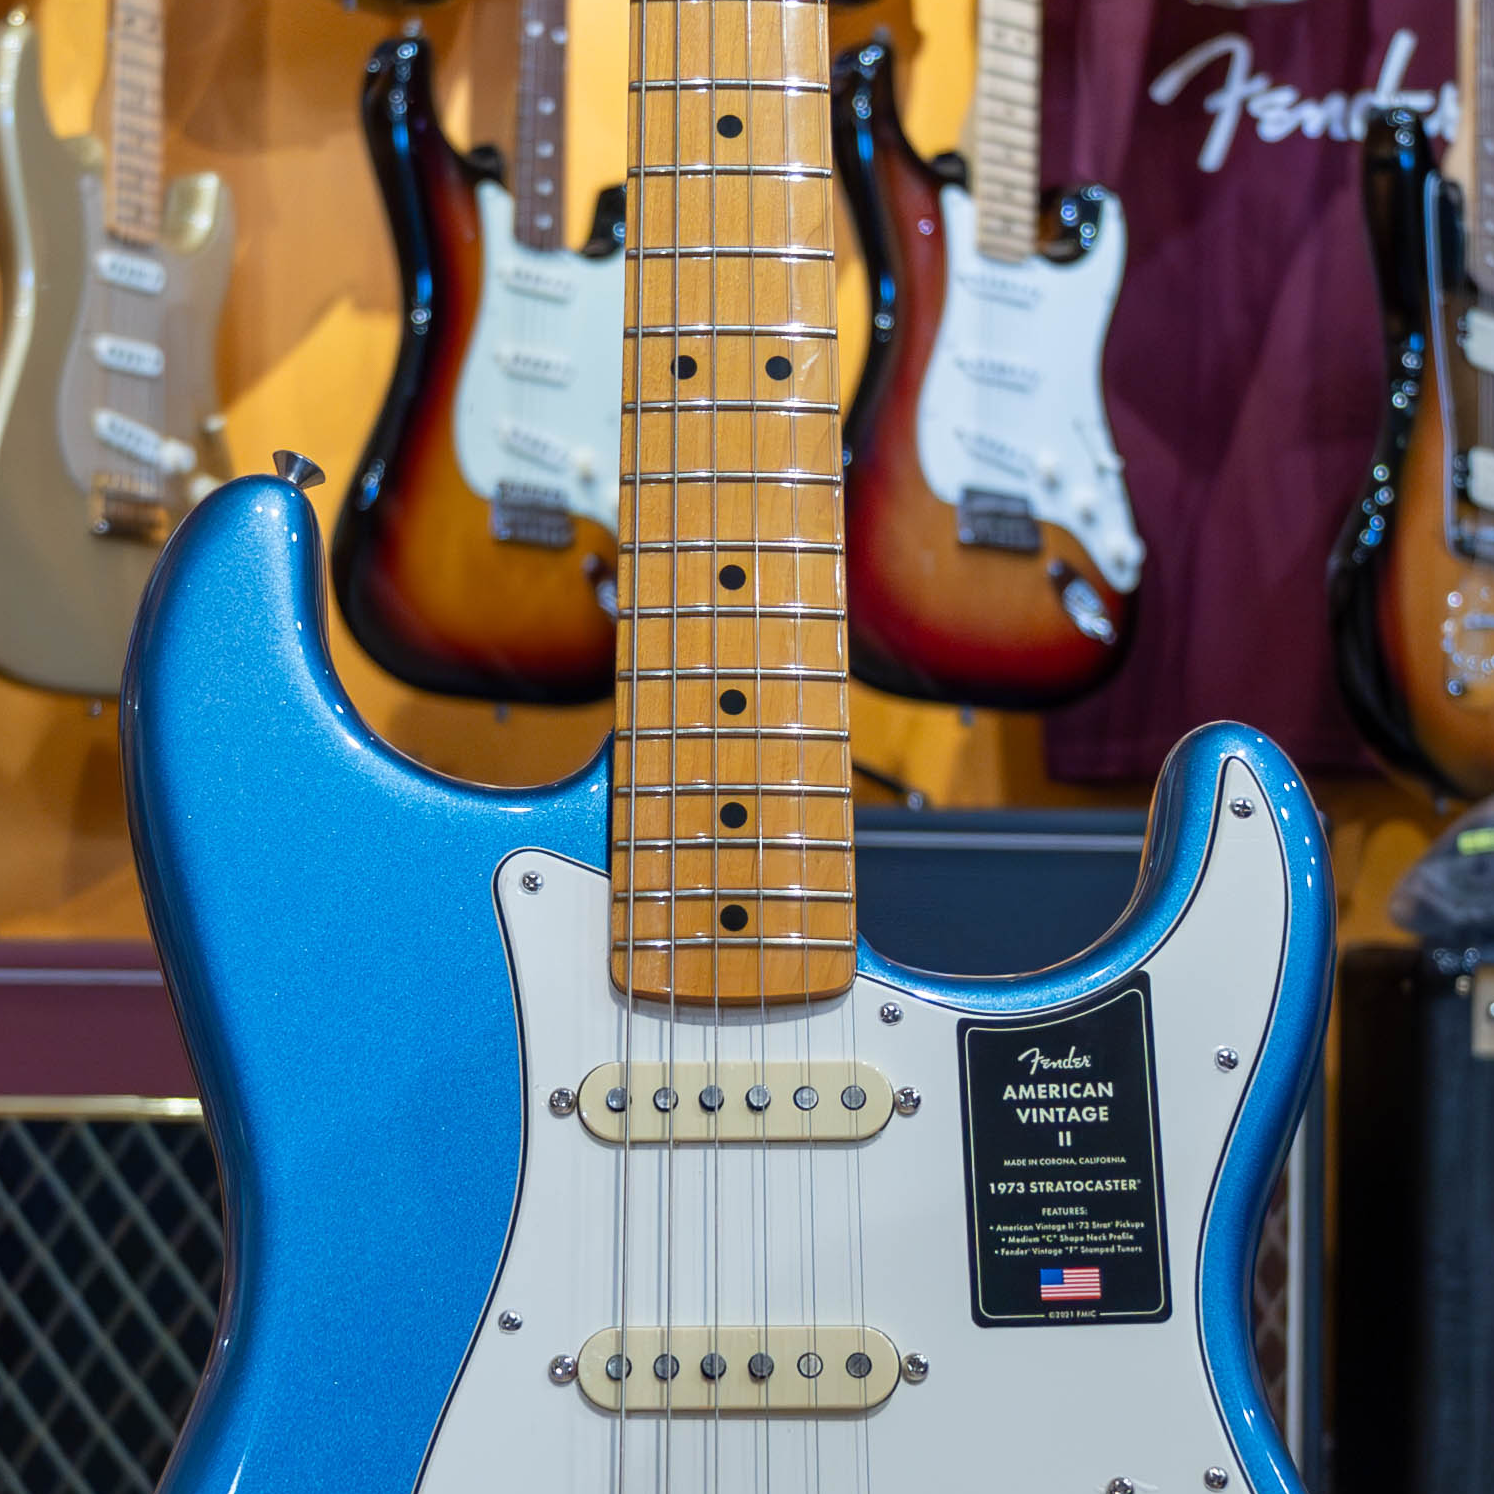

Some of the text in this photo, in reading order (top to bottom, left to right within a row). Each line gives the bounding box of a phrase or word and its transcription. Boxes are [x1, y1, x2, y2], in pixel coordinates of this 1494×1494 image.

[1018, 1046, 1091, 1075] Fender
[1003, 1082, 1113, 1100] AMERICAN
[1016, 1106, 1109, 1123] VINTAGE
[1058, 1131, 1072, 1146] II
[989, 1182, 1025, 1195] 1973
[1042, 1207, 1088, 1216] FEATURES:
[1035, 1223, 1066, 1232] Vintage
[1115, 1221, 1144, 1229] Pickups
[1008, 1236, 1039, 1244] Medium
[1060, 1235, 1084, 1243] Shape
[1032, 1247, 1063, 1256] Vintage
[1081, 1246, 1115, 1254] Stamped
[1117, 1245, 1142, 1253] Tuners
